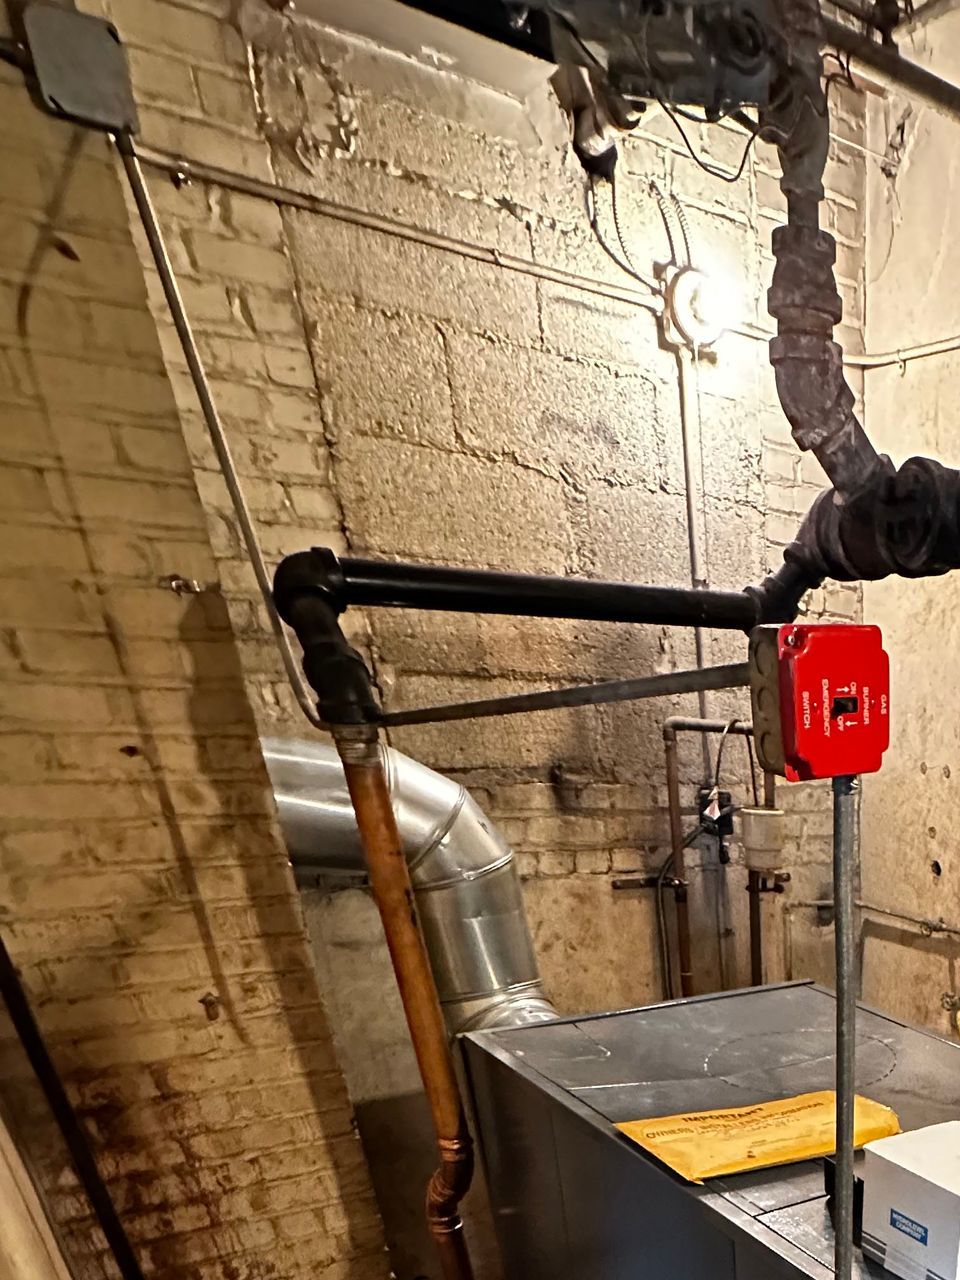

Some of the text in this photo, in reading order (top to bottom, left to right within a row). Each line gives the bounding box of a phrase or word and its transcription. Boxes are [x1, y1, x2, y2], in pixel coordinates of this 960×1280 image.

[850, 681, 857, 695] ON
[802, 690, 811, 729] SWITCH
[822, 678, 830, 738] EMERGENCY
[681, 1107, 765, 1123] IMPORTANT
